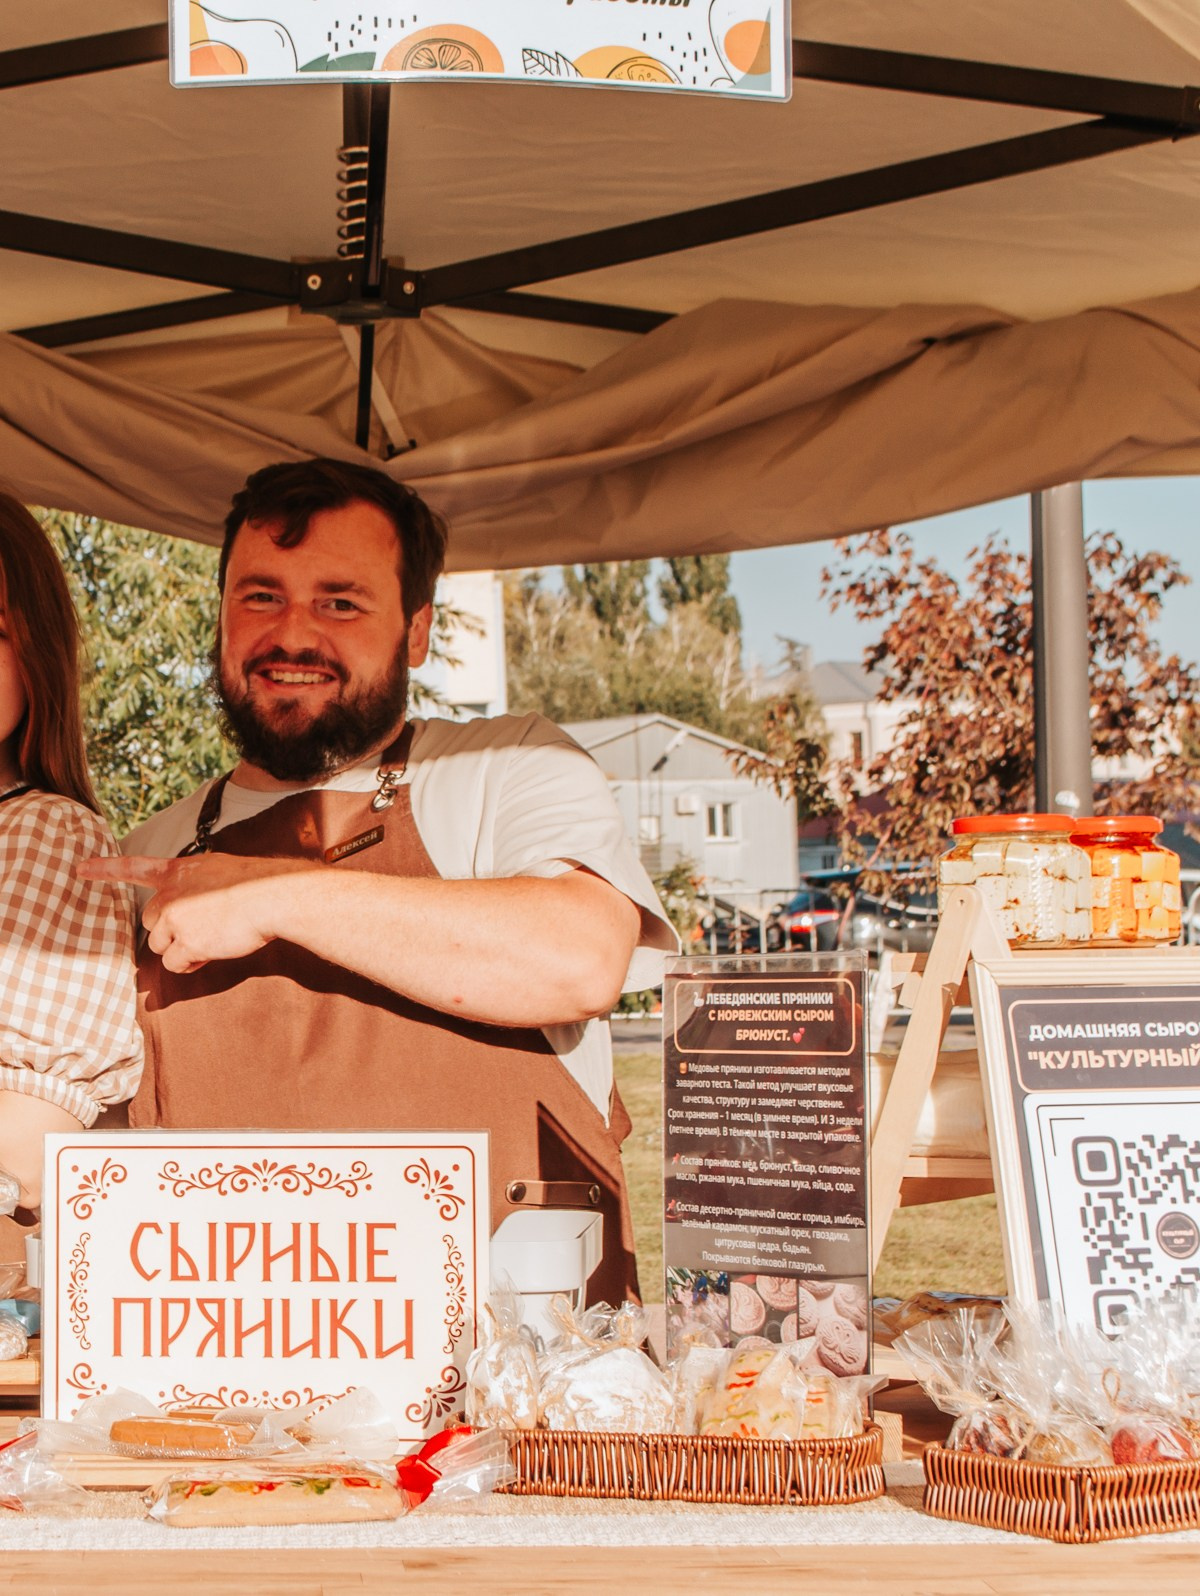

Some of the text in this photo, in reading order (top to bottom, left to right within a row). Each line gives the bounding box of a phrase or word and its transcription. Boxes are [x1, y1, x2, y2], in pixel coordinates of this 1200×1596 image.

[332, 829, 378, 857] Алексей
[706, 992, 833, 1007] ЛЕБЕДЯНСКИЕ ПРЯНИКИ
[708, 1009, 834, 1022] С НОРВЕЖСКИМ СЫРОМ
[735, 1028, 791, 1042] БРЮНУСТ.
[1029, 1021, 1200, 1042] ДОМАШНЯЯ СЫРО
[688, 1063, 850, 1078] Медовые пряники изготавливается методом
[676, 1078, 854, 1094] заварного теста. Такой метод улучшает вкусовые
[682, 1096, 845, 1109] качества, структуру и замедляет черствение.
[667, 1108, 684, 1120] Срок
[684, 1111, 719, 1121] хранения
[725, 1111, 729, 1121] 1
[731, 1114, 753, 1124] месяц
[753, 1112, 761, 1125] (в
[763, 1115, 790, 1124] зимнее
[792, 1115, 819, 1126] время).
[821, 1115, 827, 1125] И
[829, 1115, 834, 1125] 3
[836, 1117, 863, 1127] недели
[668, 1124, 862, 1144] (летнее время). В тёмном месте в закрытой упаковке.
[680, 1155, 861, 1176] Состав пряников: мёд, брюнуст, сахар, сливочное
[675, 1172, 856, 1193] масло, ржаная мука, пшеничная мука, яйца, сода.
[676, 1201, 699, 1213] Состав
[700, 1205, 776, 1221] десертно-пряничной
[802, 1212, 833, 1225] корица,
[834, 1214, 866, 1228] имбирь,
[750, 1225, 790, 1237] мускатный
[791, 1229, 811, 1240] орех,
[812, 1230, 850, 1242] гвоздика,
[129, 1222, 397, 1282] СЫРНЫЕ
[714, 1238, 812, 1255] цитрусовая цедра, бадьян.
[702, 1250, 827, 1273] Покрываются белковой глазурью.
[112, 1297, 416, 1359] ПРЯНИКИ
